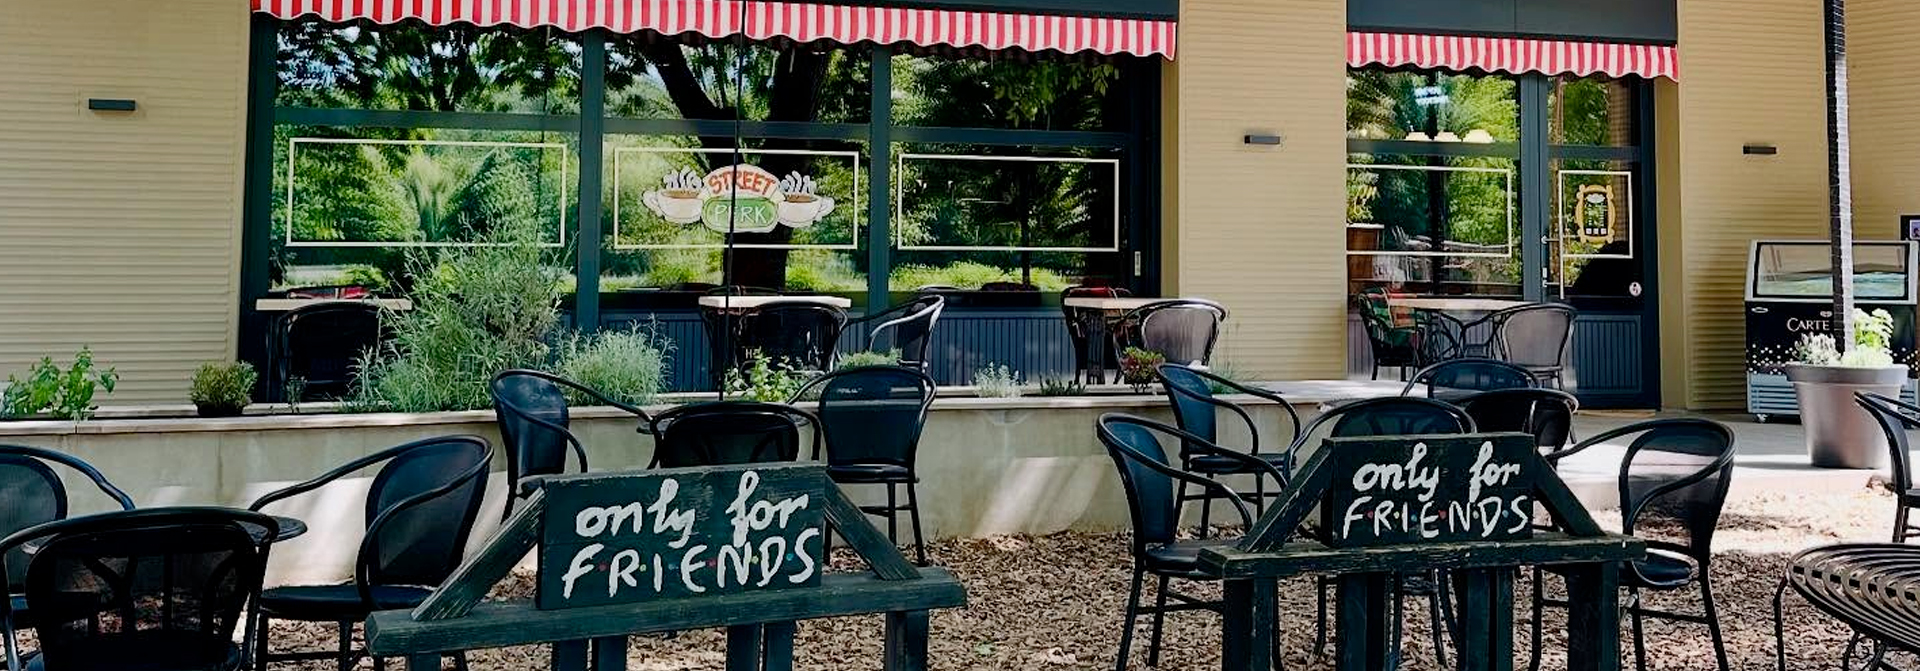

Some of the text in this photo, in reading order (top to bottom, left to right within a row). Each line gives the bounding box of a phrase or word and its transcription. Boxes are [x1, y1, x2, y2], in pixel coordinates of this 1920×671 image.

[708, 169, 777, 195] STREET
[1786, 317, 1830, 332] CARTE
[1352, 440, 1521, 503] only for
[575, 470, 810, 549] only for
